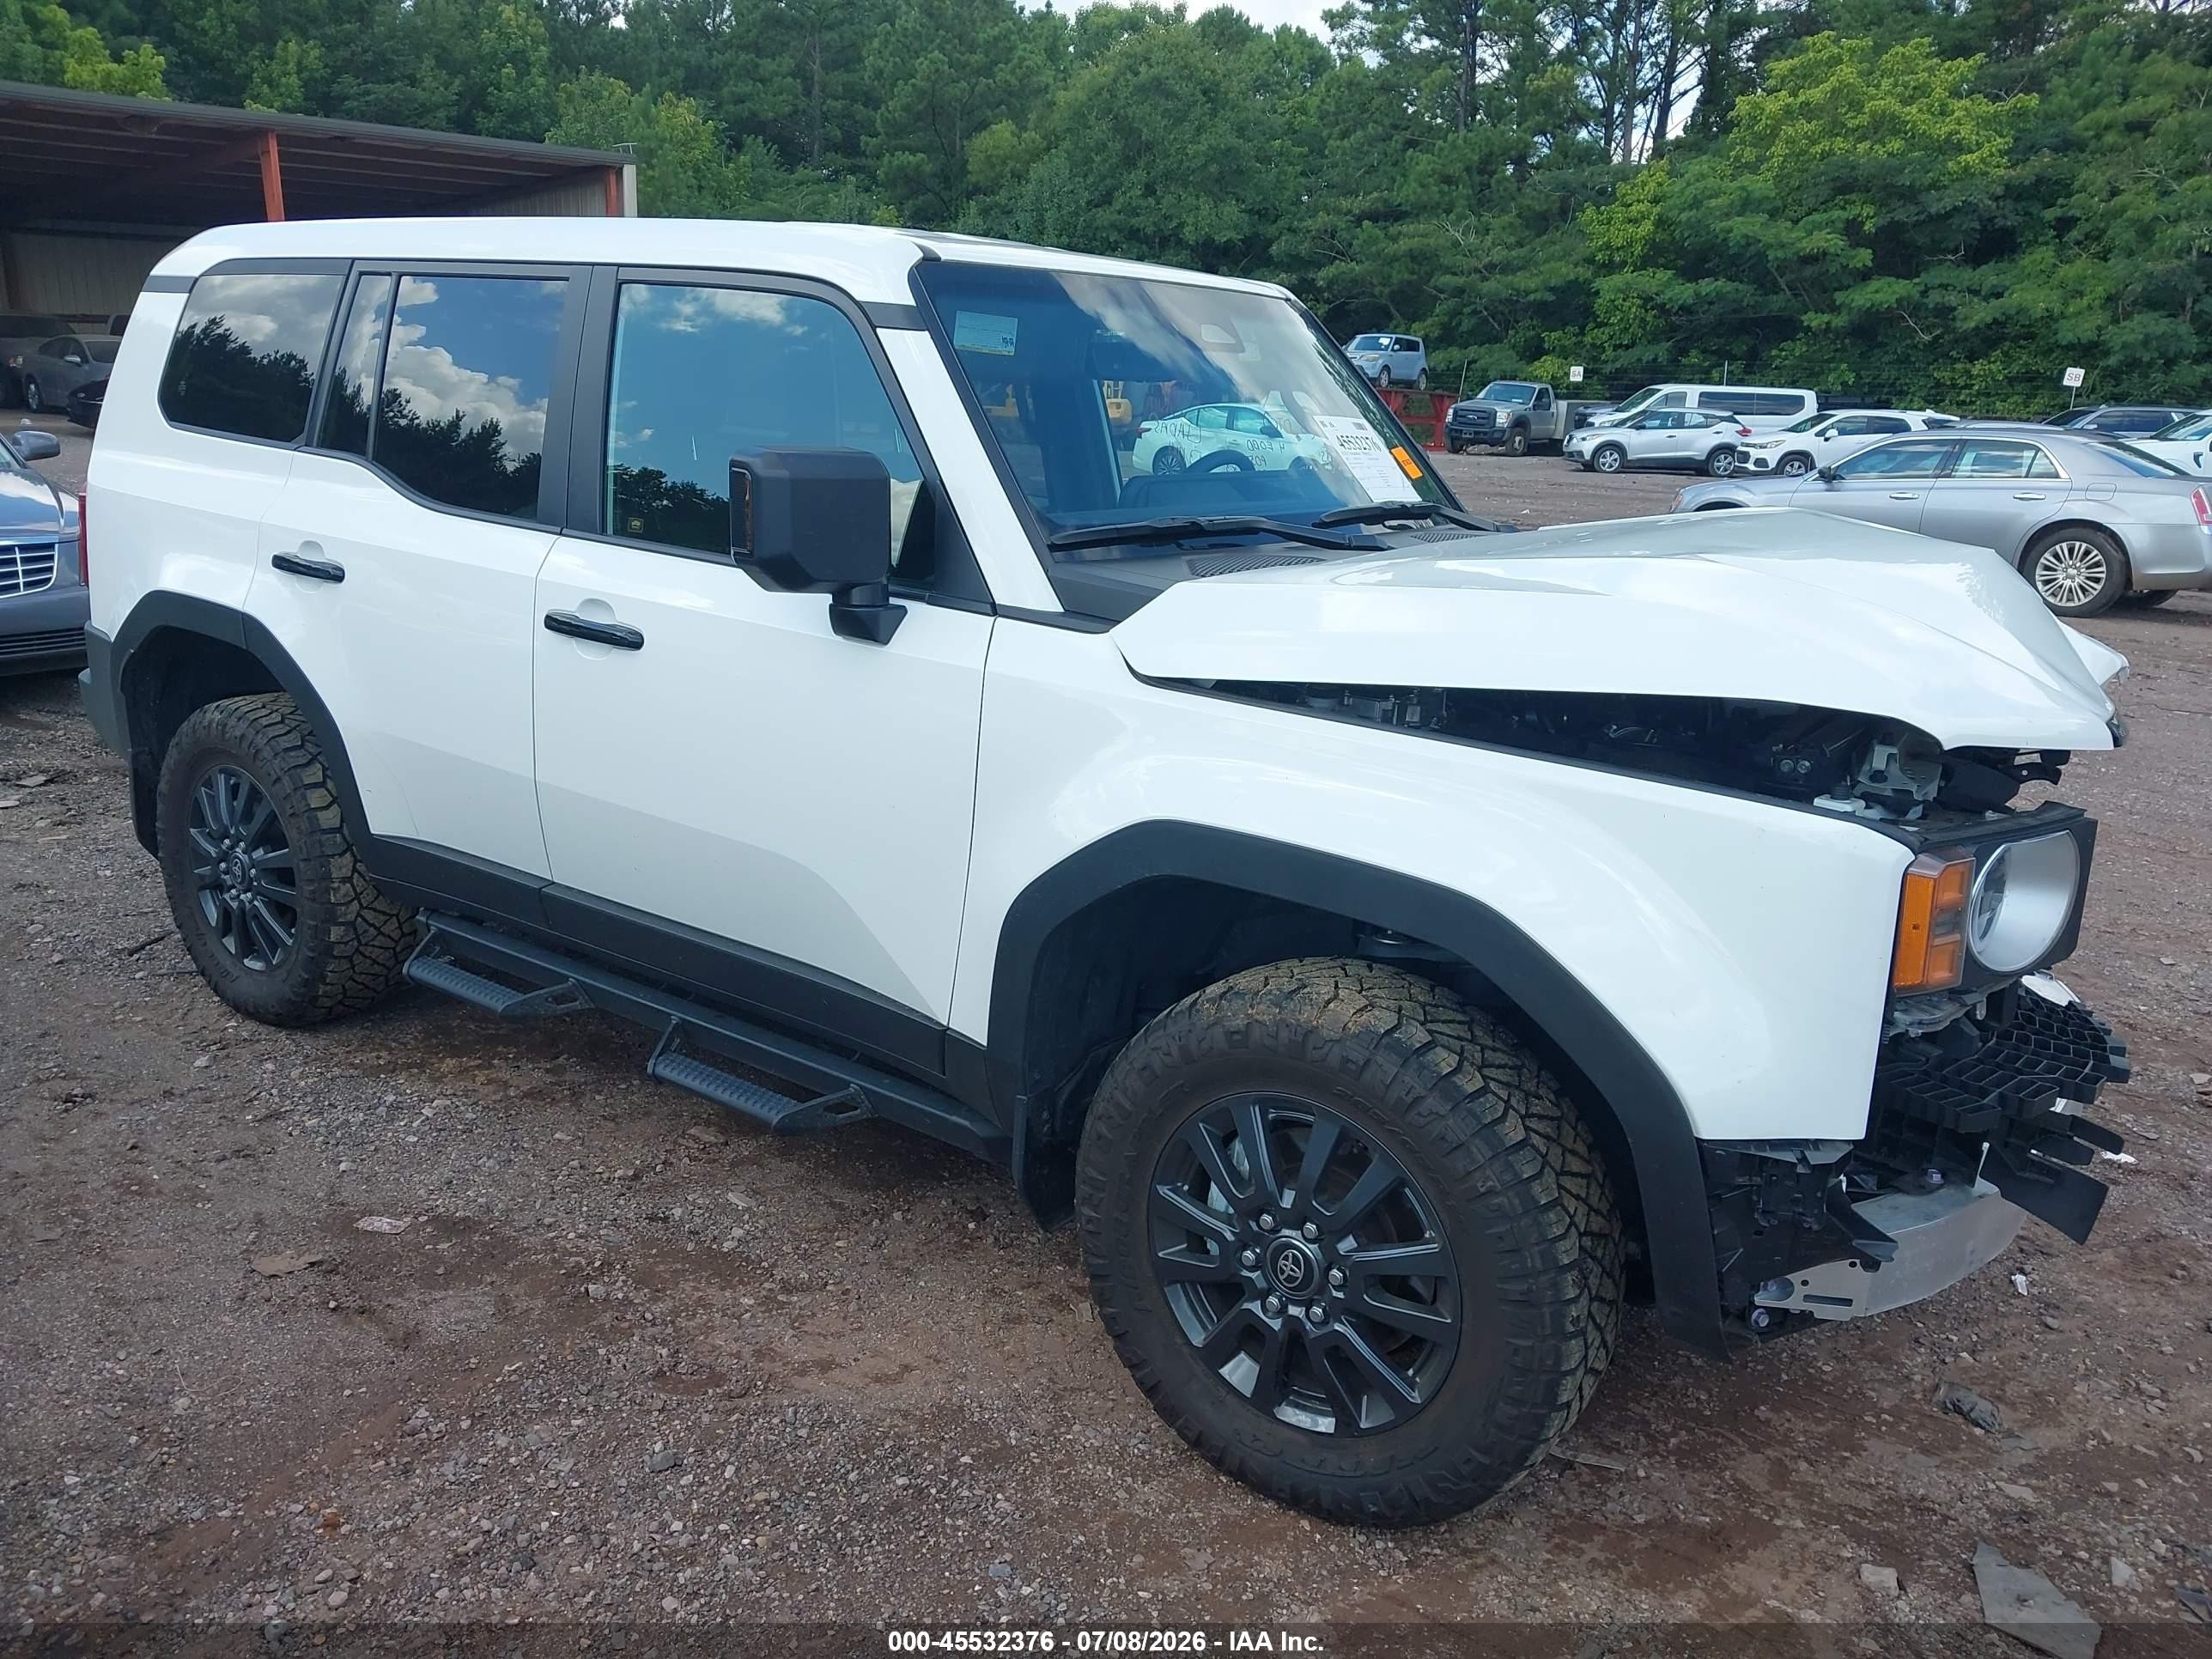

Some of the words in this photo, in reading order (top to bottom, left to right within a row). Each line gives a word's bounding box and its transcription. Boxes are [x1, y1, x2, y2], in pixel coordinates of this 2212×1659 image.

[1571, 370, 1581, 379] SA
[2067, 373, 2081, 382] SB
[1335, 434, 1382, 453] 45532376
